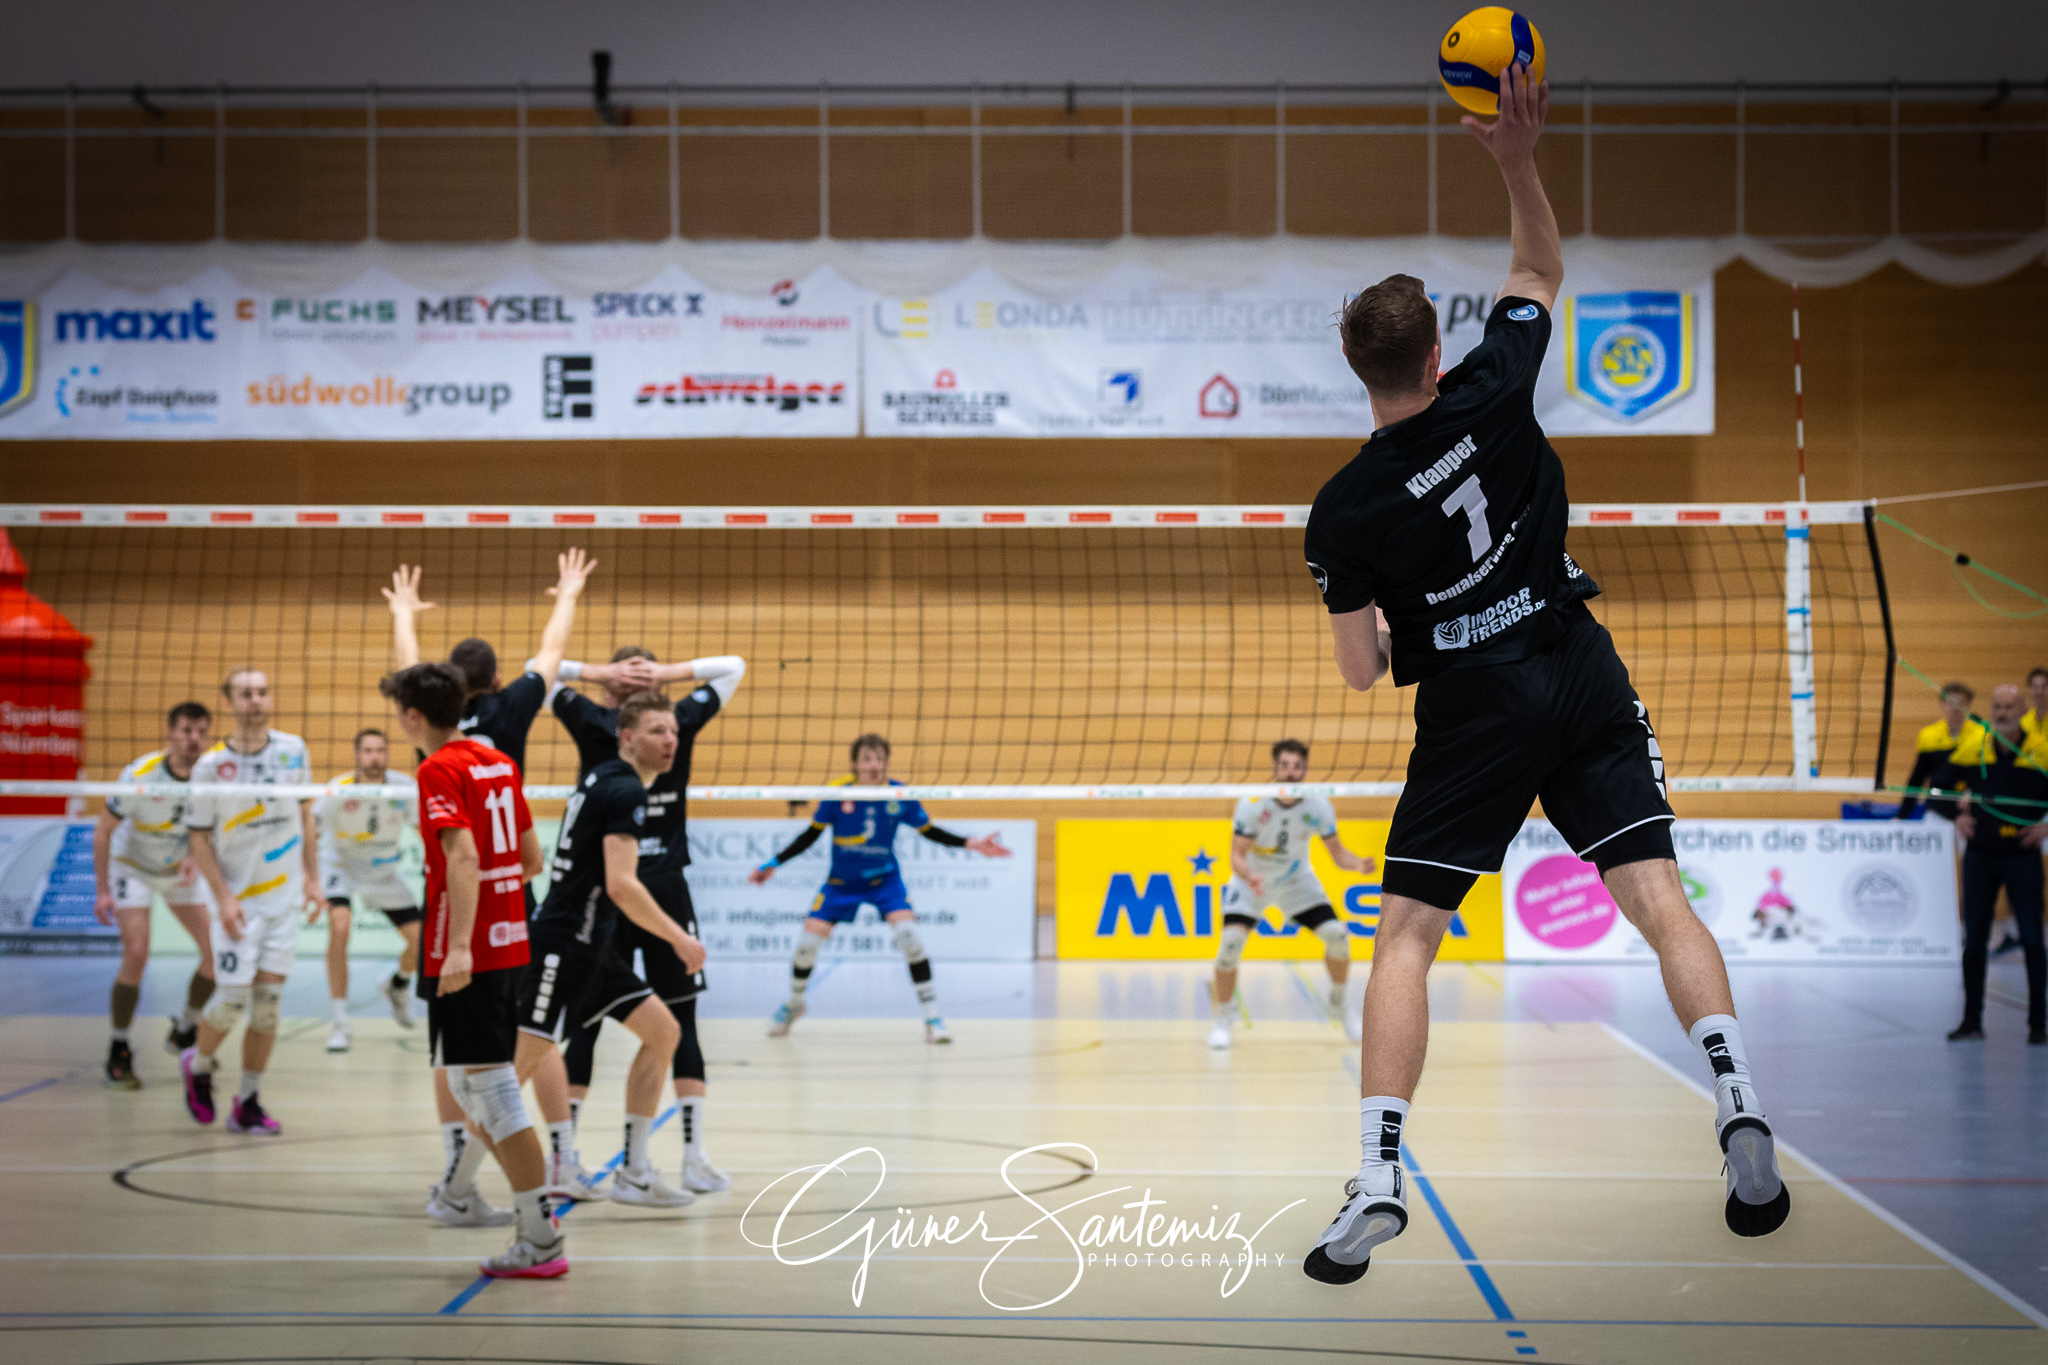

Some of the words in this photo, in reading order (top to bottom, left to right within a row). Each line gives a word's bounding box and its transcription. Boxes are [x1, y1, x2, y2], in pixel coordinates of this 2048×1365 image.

[56, 300, 216, 342] maxit
[271, 300, 397, 323] FUCHS
[416, 297, 574, 324] MEYSEL
[592, 292, 677, 317] SPECK
[956, 302, 1089, 329] LEONDA
[1446, 293, 1498, 332] pu
[1405, 434, 1478, 499] Klapper
[1470, 586, 1532, 631] INDOOR
[485, 785, 518, 855] 11
[1511, 826, 1567, 851] Hie
[1672, 826, 1753, 852] rchen
[1762, 827, 1807, 852] die
[1816, 827, 1944, 852] Smarten
